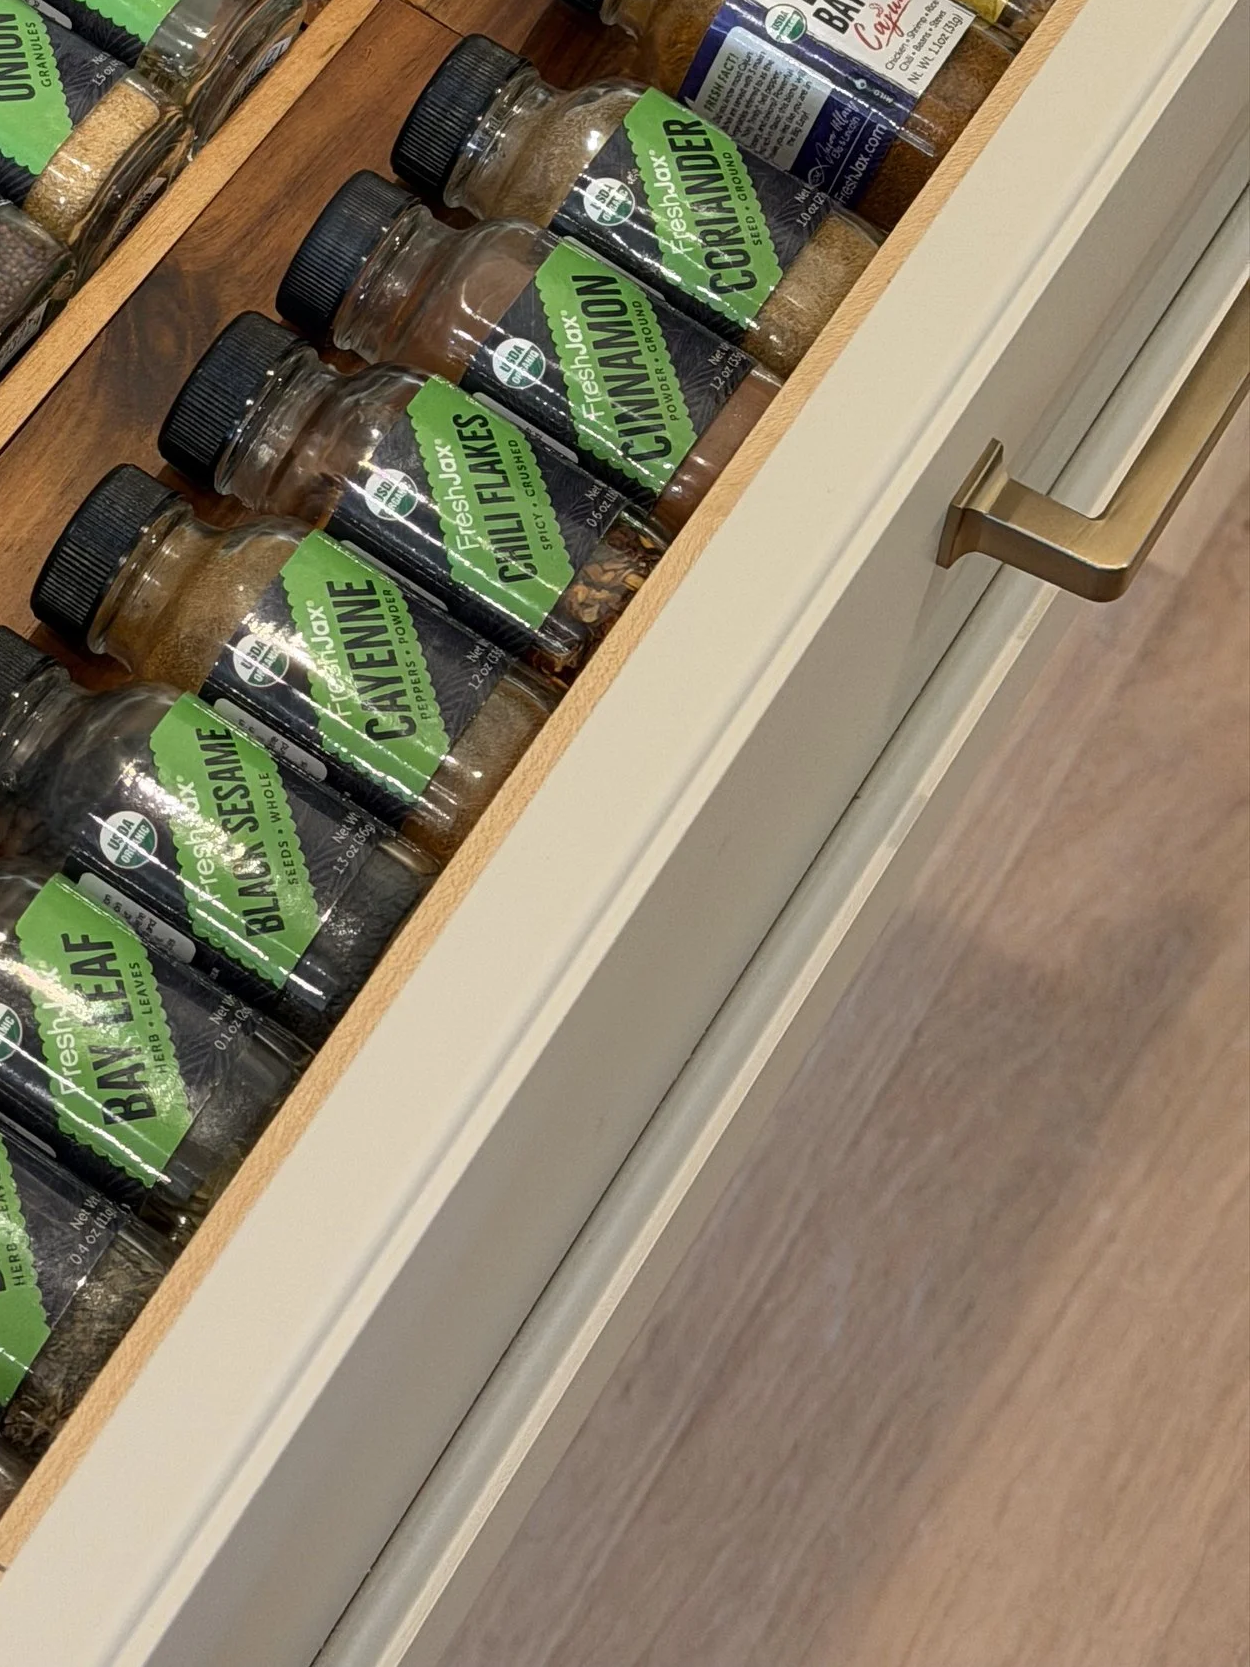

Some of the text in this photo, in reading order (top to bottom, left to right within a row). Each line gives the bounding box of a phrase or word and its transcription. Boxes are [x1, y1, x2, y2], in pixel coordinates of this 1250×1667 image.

[25, 22, 52, 88] GRANULES
[704, 52, 737, 112] FRESH FACT!
[886, 0, 940, 70] Chicken Shrimp Rice
[900, 10, 947, 71] Chili Beans Stews
[873, 89, 893, 103] MILD
[663, 120, 758, 295] CORIANDER
[722, 152, 761, 246] SEED GROUND
[834, 123, 888, 204] FreshJax.com
[572, 275, 671, 461] CINNAMON
[631, 301, 680, 422] POWDER GROUND
[453, 414, 538, 584] CHILI FLAKES
[508, 439, 551, 551] SPICY CRUSHED
[327, 580, 416, 741] CAYENNE
[382, 589, 430, 719] PEPPERS POWDER
[196, 728, 260, 833] SESAME
[258, 772, 298, 884] SEEDS WHOLE
[61, 933, 155, 1126] BAY LEAF
[129, 962, 168, 1075] HERB LEAVES
[6, 1244, 23, 1287] HERB
